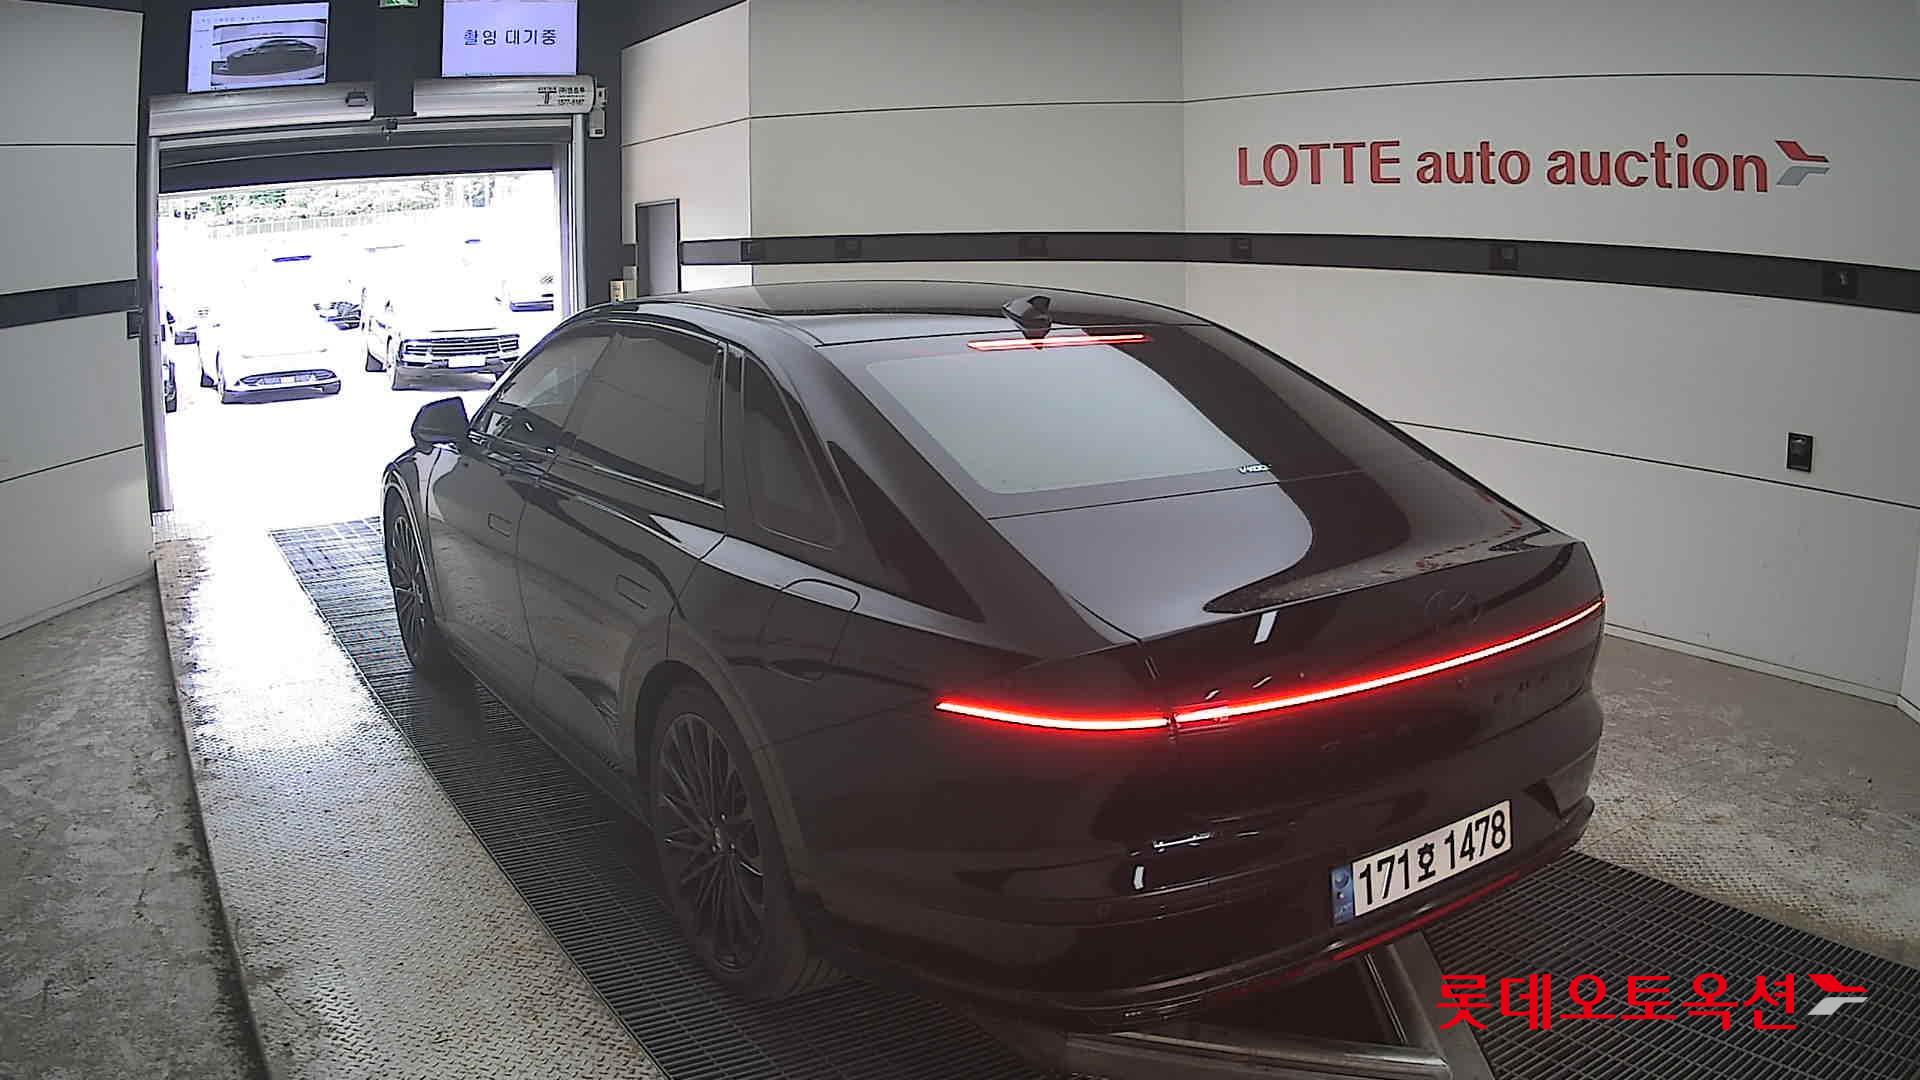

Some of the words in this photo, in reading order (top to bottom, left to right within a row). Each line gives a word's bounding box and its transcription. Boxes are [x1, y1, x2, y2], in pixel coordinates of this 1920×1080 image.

[505, 28, 557, 46] 대기중
[1238, 140, 1401, 187] LOTTE
[1416, 141, 1531, 186] auto
[1546, 133, 1769, 193] auction
[1359, 842, 1436, 905] 171호
[1444, 809, 1507, 870] 1478
